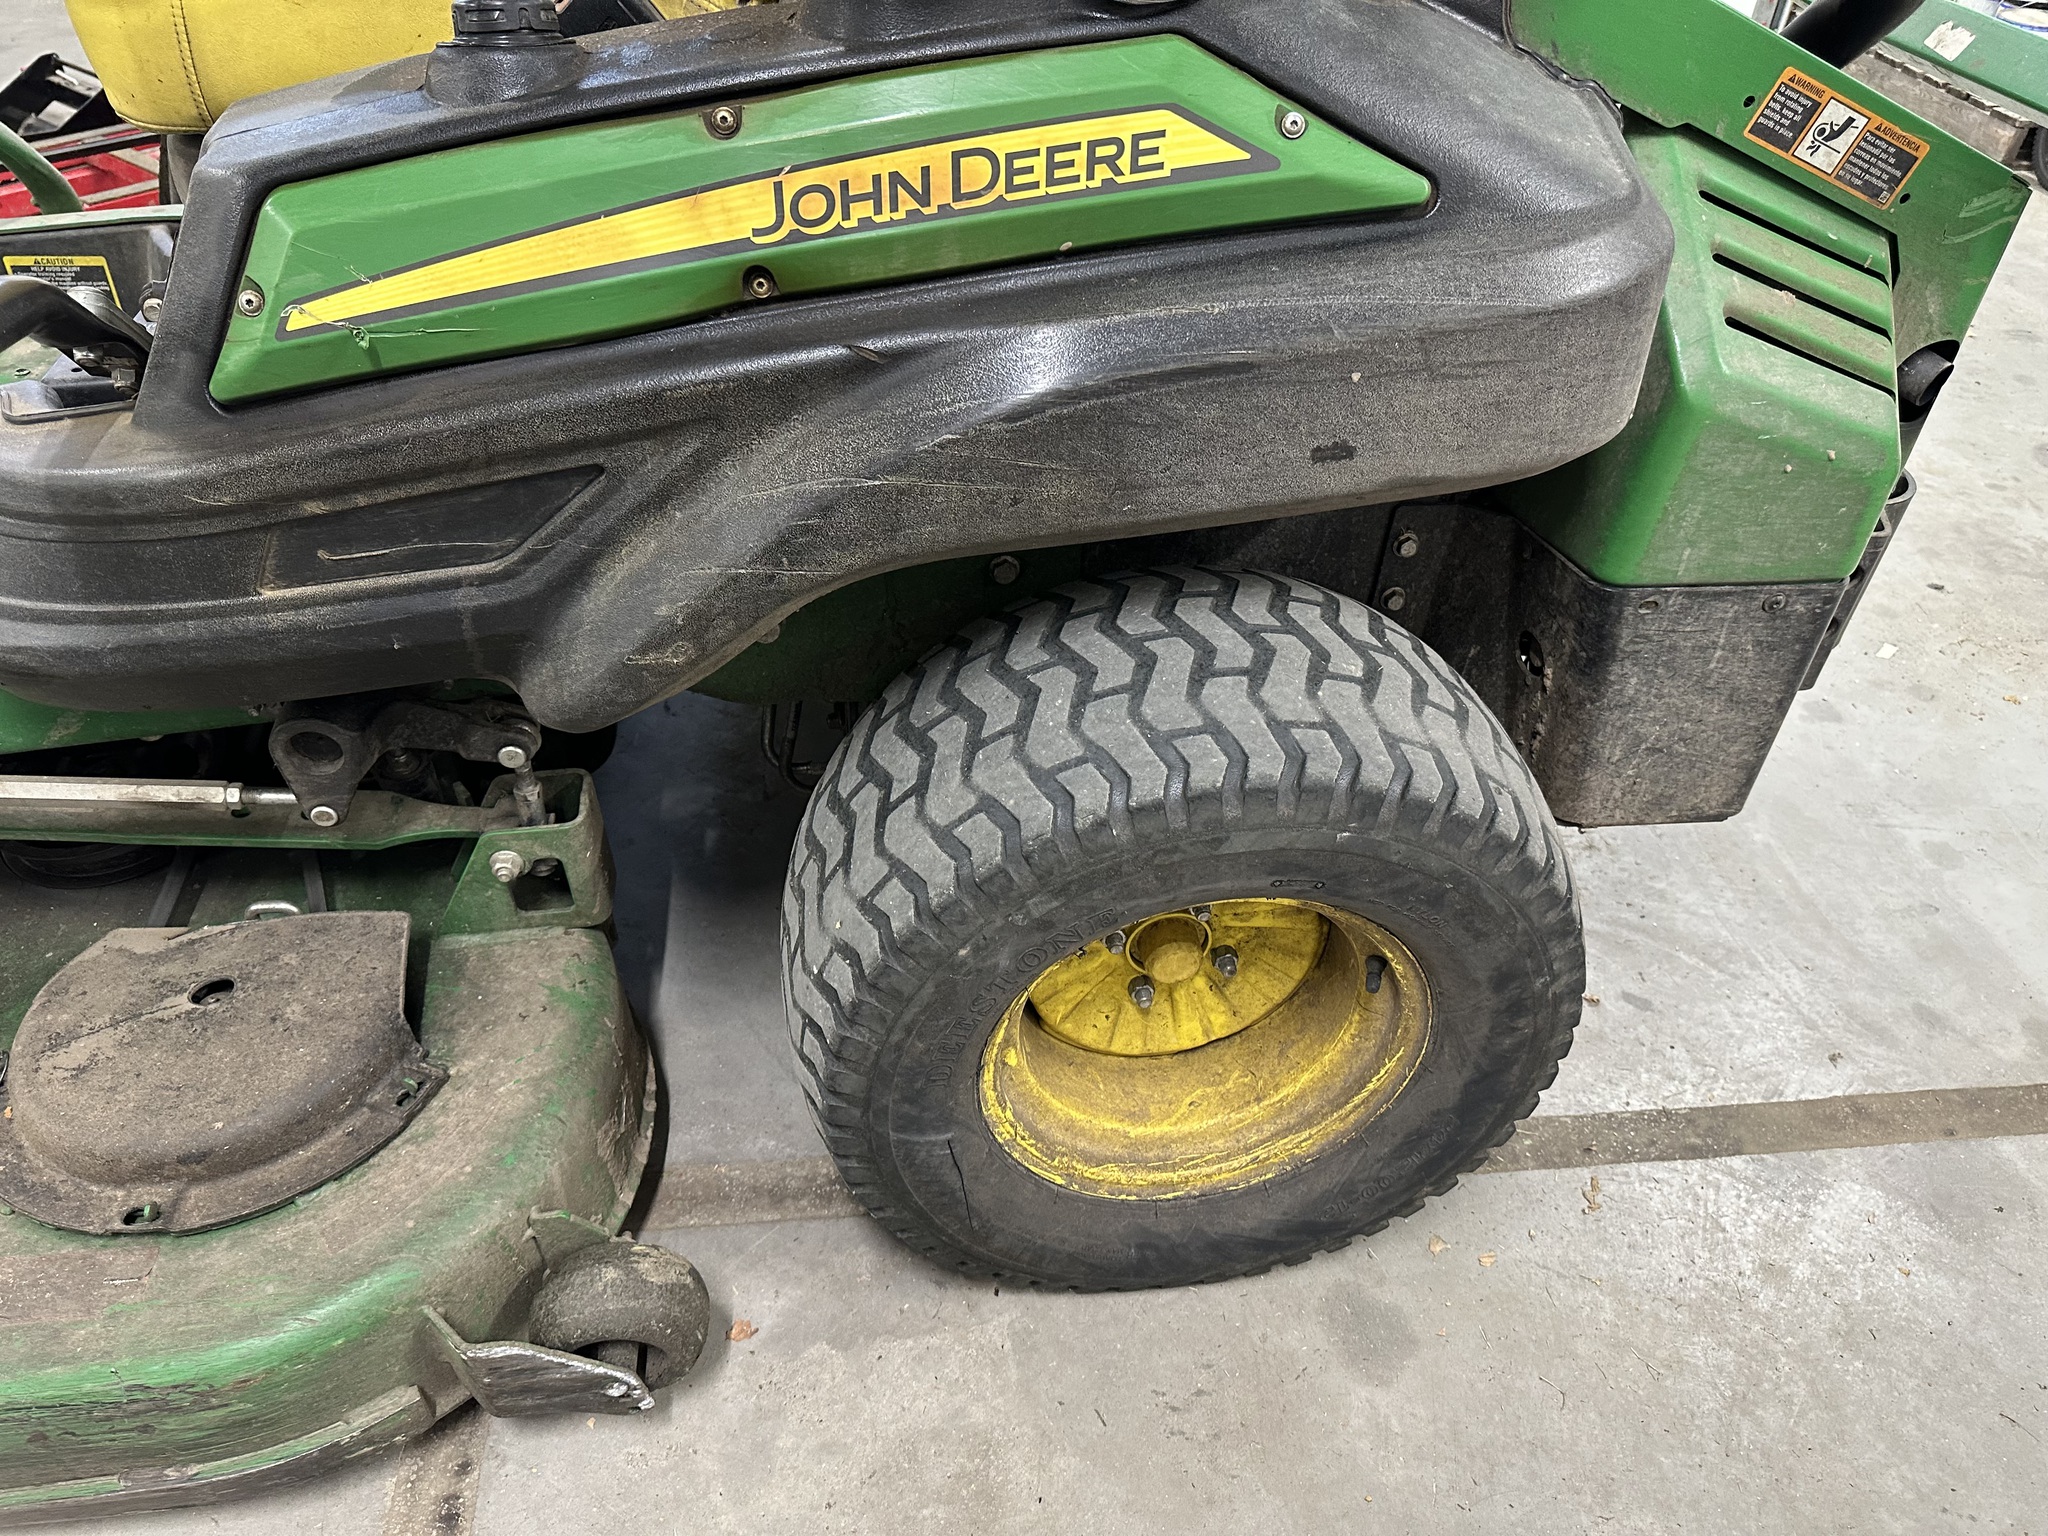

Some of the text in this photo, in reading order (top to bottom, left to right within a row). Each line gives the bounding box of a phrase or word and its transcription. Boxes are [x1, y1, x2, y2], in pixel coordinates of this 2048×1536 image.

[1779, 84, 1812, 108] To avoid injury
[1795, 77, 1825, 99] WARNING
[1768, 101, 1782, 112] belts,
[1782, 107, 1794, 119] keep
[1773, 93, 1803, 113] from rotating
[1757, 116, 1774, 128] guards
[1778, 128, 1793, 139] place.
[1763, 108, 1790, 126] shields and
[1881, 126, 1920, 153] ADVERTENCIA
[752, 129, 1166, 237] JOHN DEERE
[923, 907, 1118, 1088] DEESTONE
